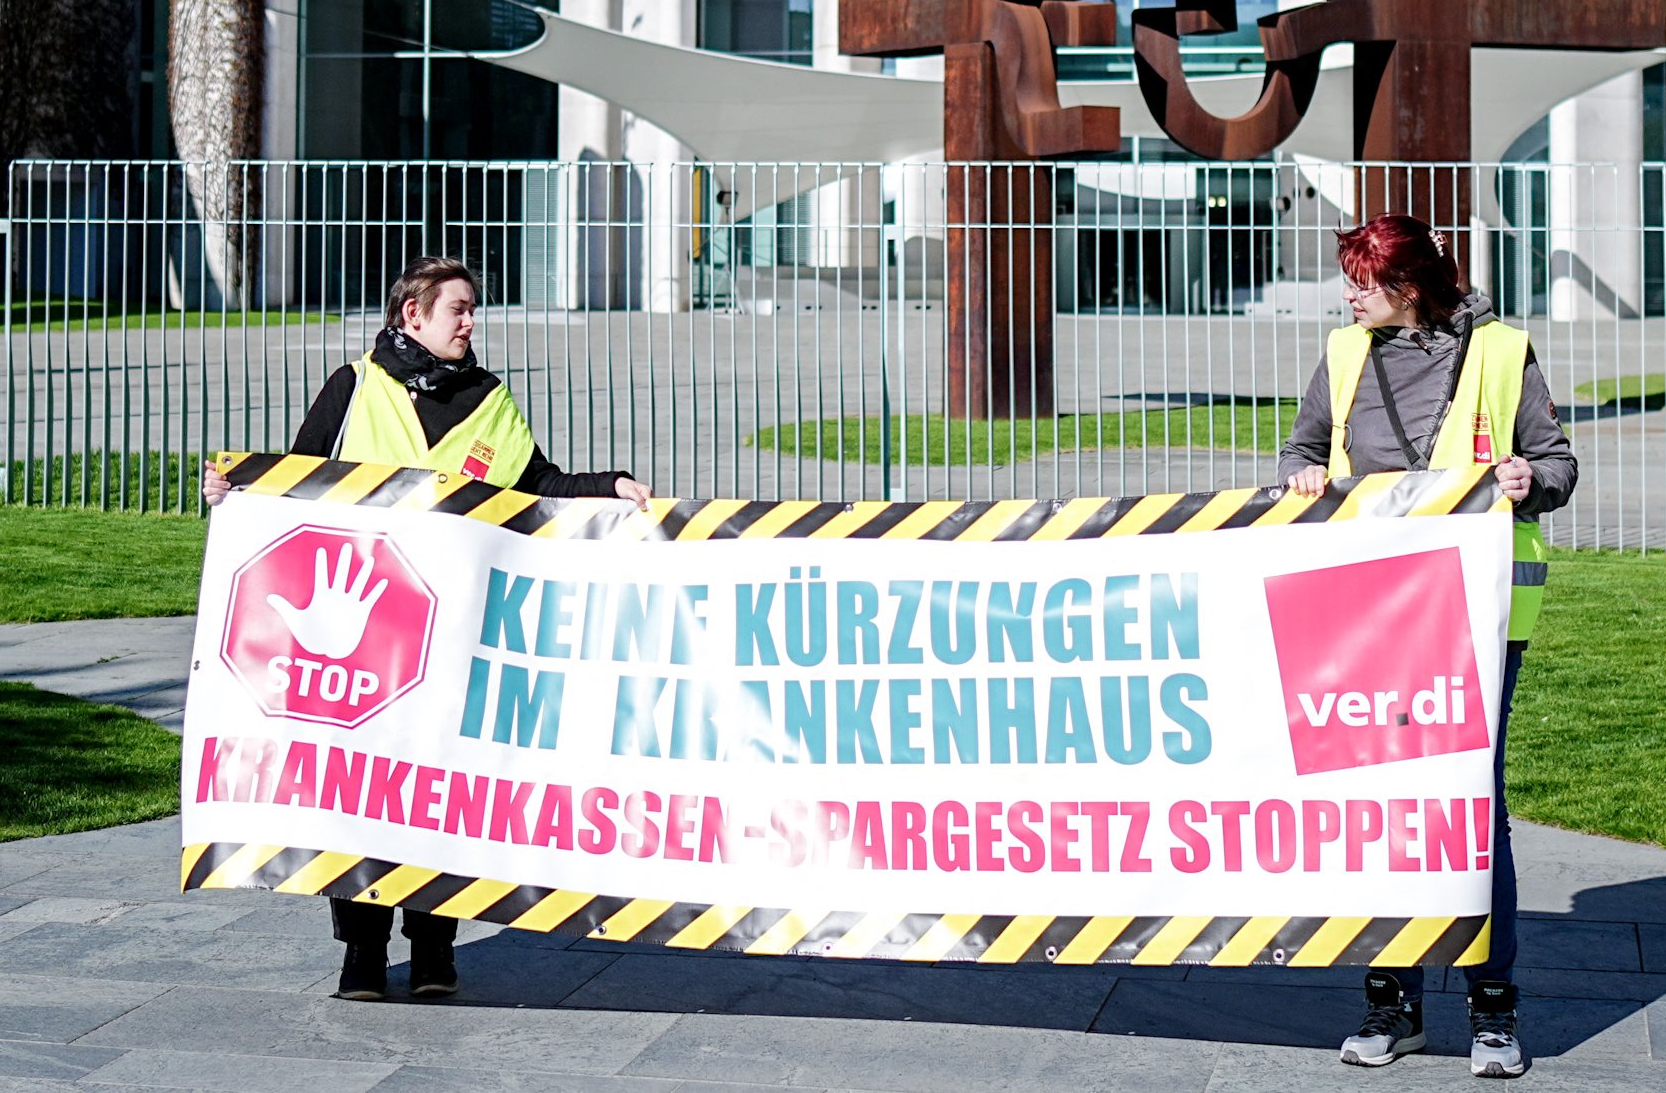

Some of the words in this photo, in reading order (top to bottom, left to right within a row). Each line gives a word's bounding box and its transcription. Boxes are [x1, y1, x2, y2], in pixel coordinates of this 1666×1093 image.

[480, 567, 708, 664] KEINE
[734, 565, 1201, 667] KÜRZUNGEN
[266, 656, 379, 706] STOP
[459, 655, 566, 750] IM
[1297, 675, 1467, 728] ver.di
[195, 736, 1152, 873] KRANKENKASSEN-SPARGESETZ
[1167, 797, 1491, 874] STOPPEN!
